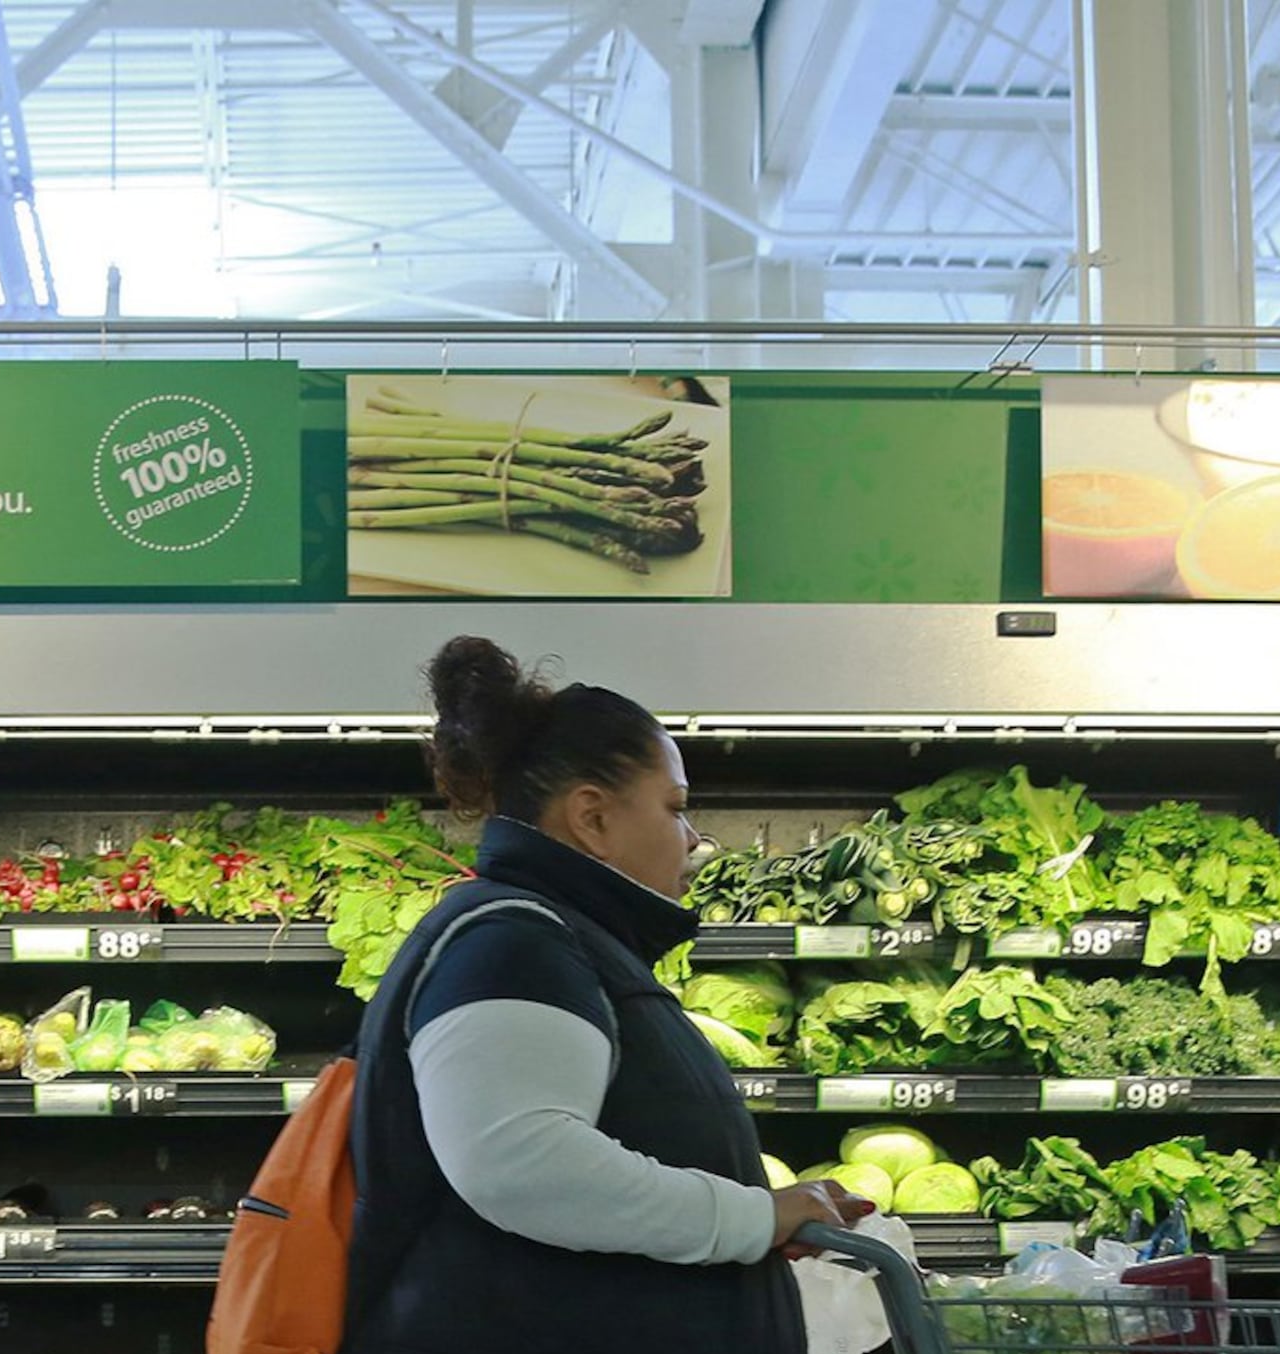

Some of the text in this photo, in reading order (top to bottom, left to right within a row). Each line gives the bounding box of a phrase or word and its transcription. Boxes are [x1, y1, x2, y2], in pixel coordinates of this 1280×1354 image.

[112, 416, 210, 464] freshness
[120, 437, 227, 499] 100%
[126, 464, 243, 530] guaranteed
